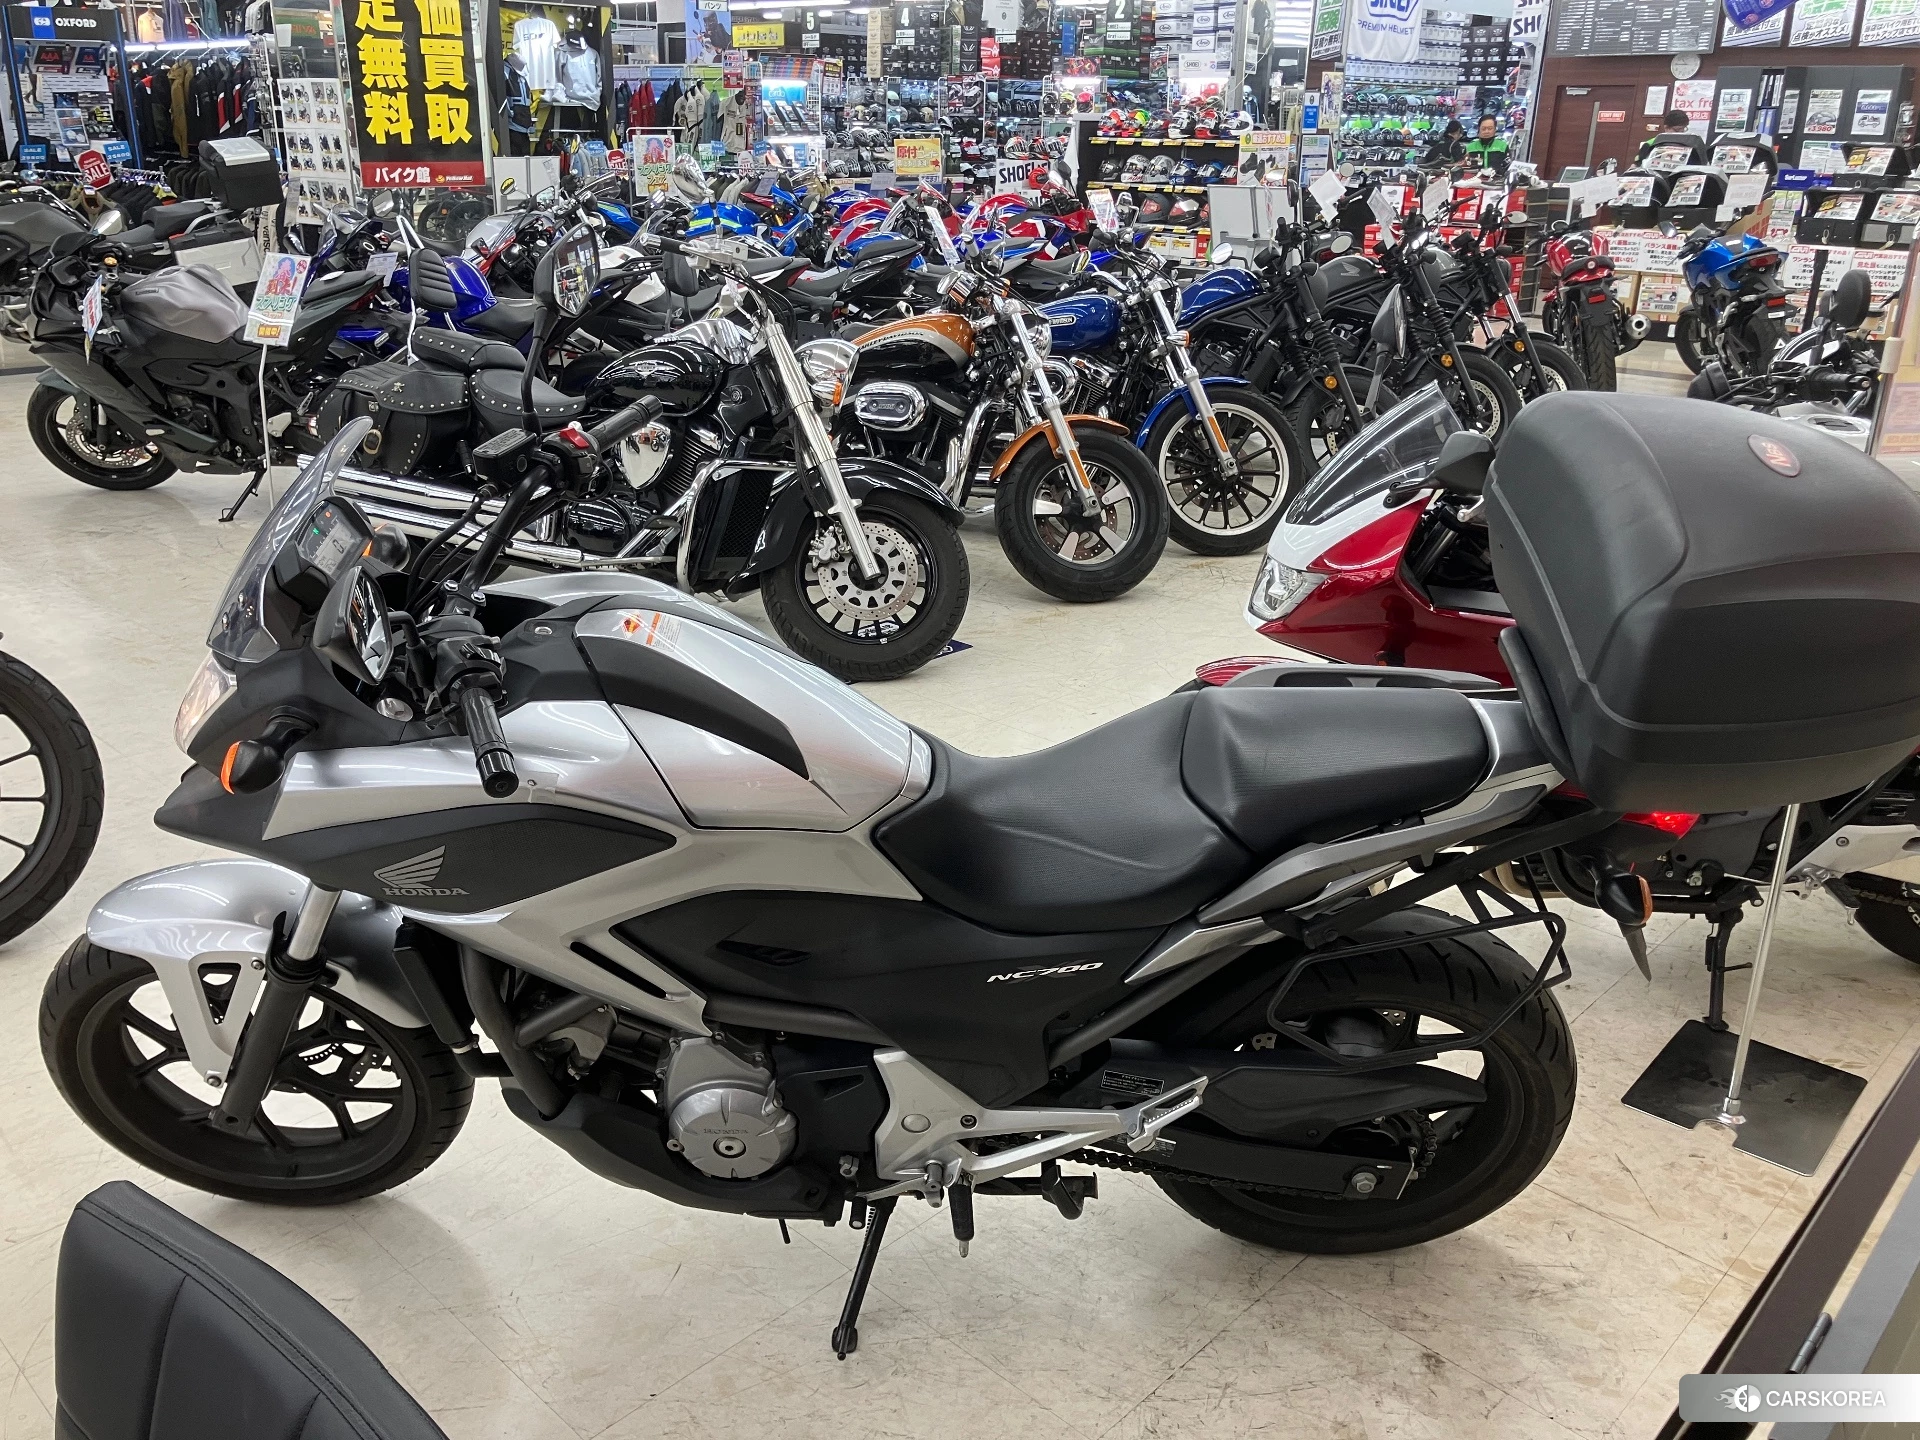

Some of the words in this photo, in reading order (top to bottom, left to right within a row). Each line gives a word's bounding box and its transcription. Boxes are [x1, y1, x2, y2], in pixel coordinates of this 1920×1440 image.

[704, 1, 721, 9] パンツ
[1114, 0, 1126, 19] 2
[55, 17, 97, 28] OXFORD
[806, 12, 815, 30] 5
[900, 8, 910, 26] 4
[1674, 98, 1694, 109] tax
[84, 162, 110, 182] SALE
[374, 166, 431, 183] バイク館
[381, 887, 470, 896] HONDA
[986, 962, 1104, 983] NC700
